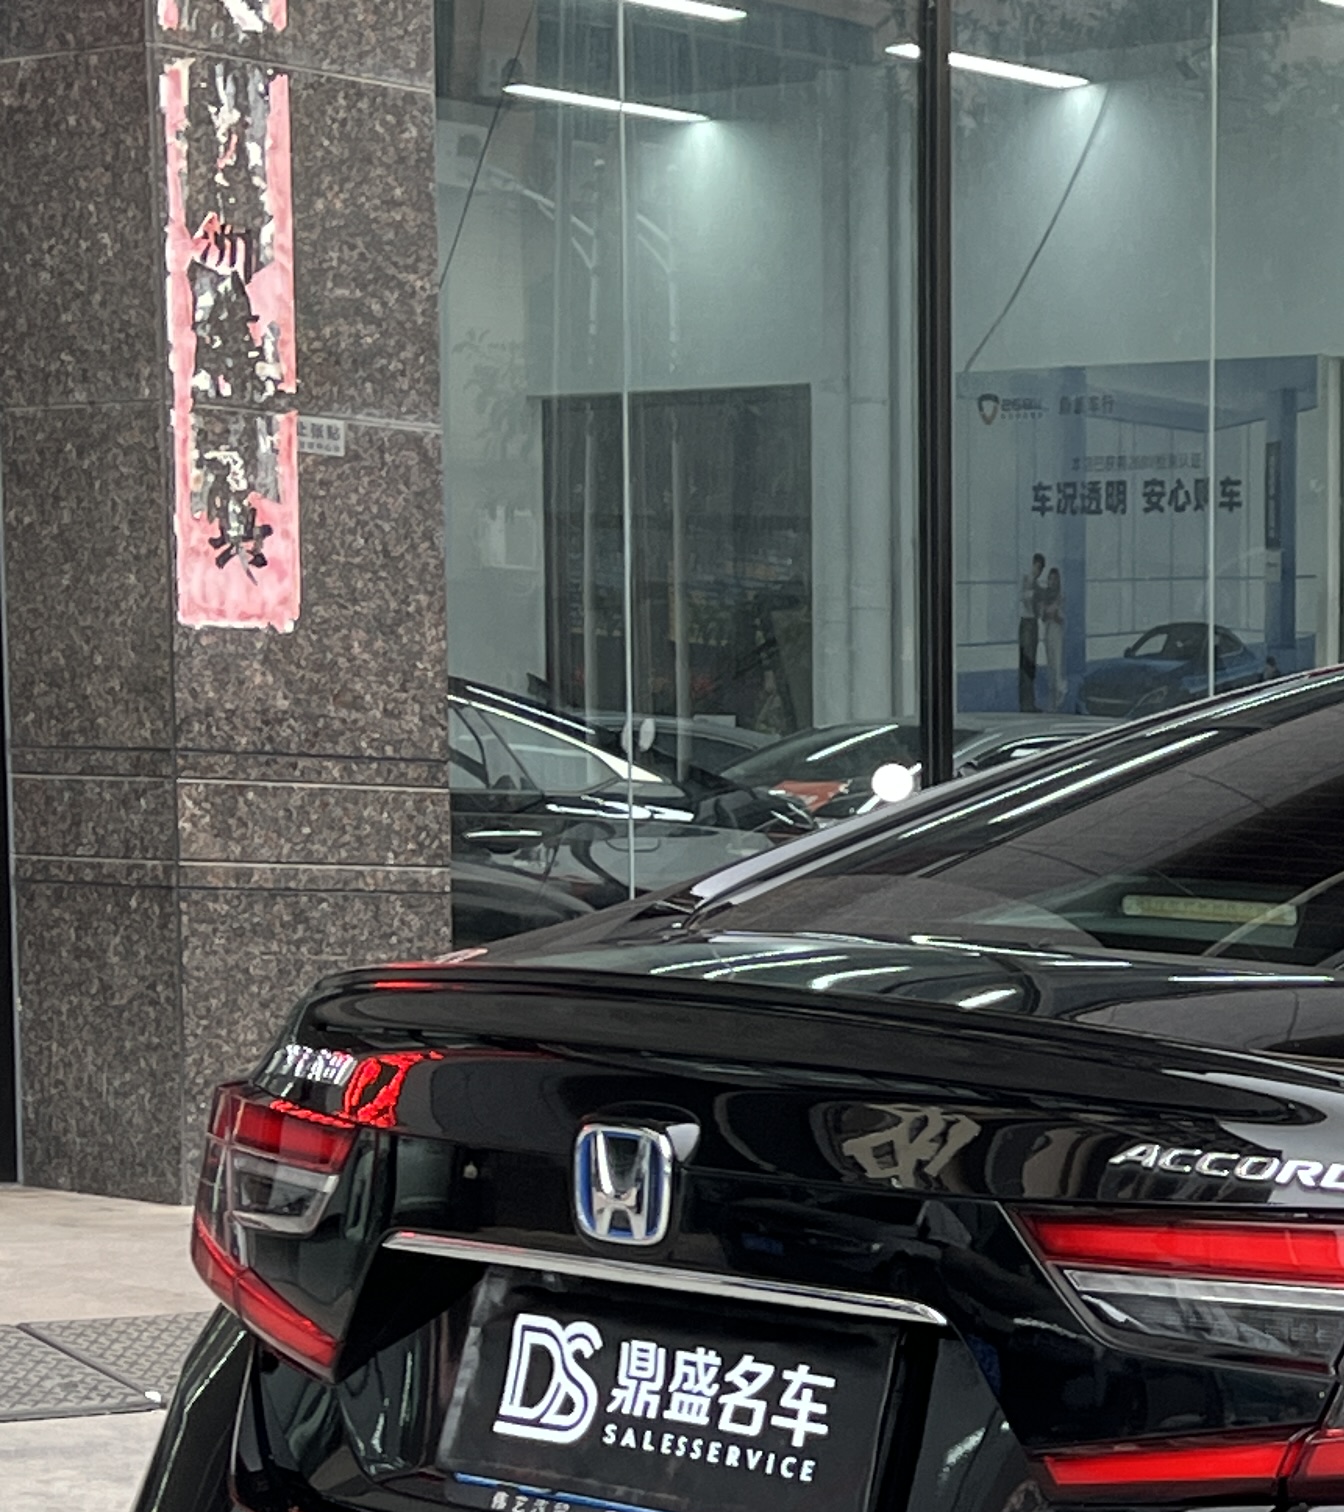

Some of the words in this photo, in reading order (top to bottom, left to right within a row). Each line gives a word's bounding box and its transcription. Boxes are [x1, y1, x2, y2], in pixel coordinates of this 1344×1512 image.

[1031, 479, 1128, 518] 车况透明
[492, 1312, 604, 1445] DS
[606, 1339, 837, 1448] 鼎盛名车
[602, 1423, 817, 1482] SALESSERVICE
